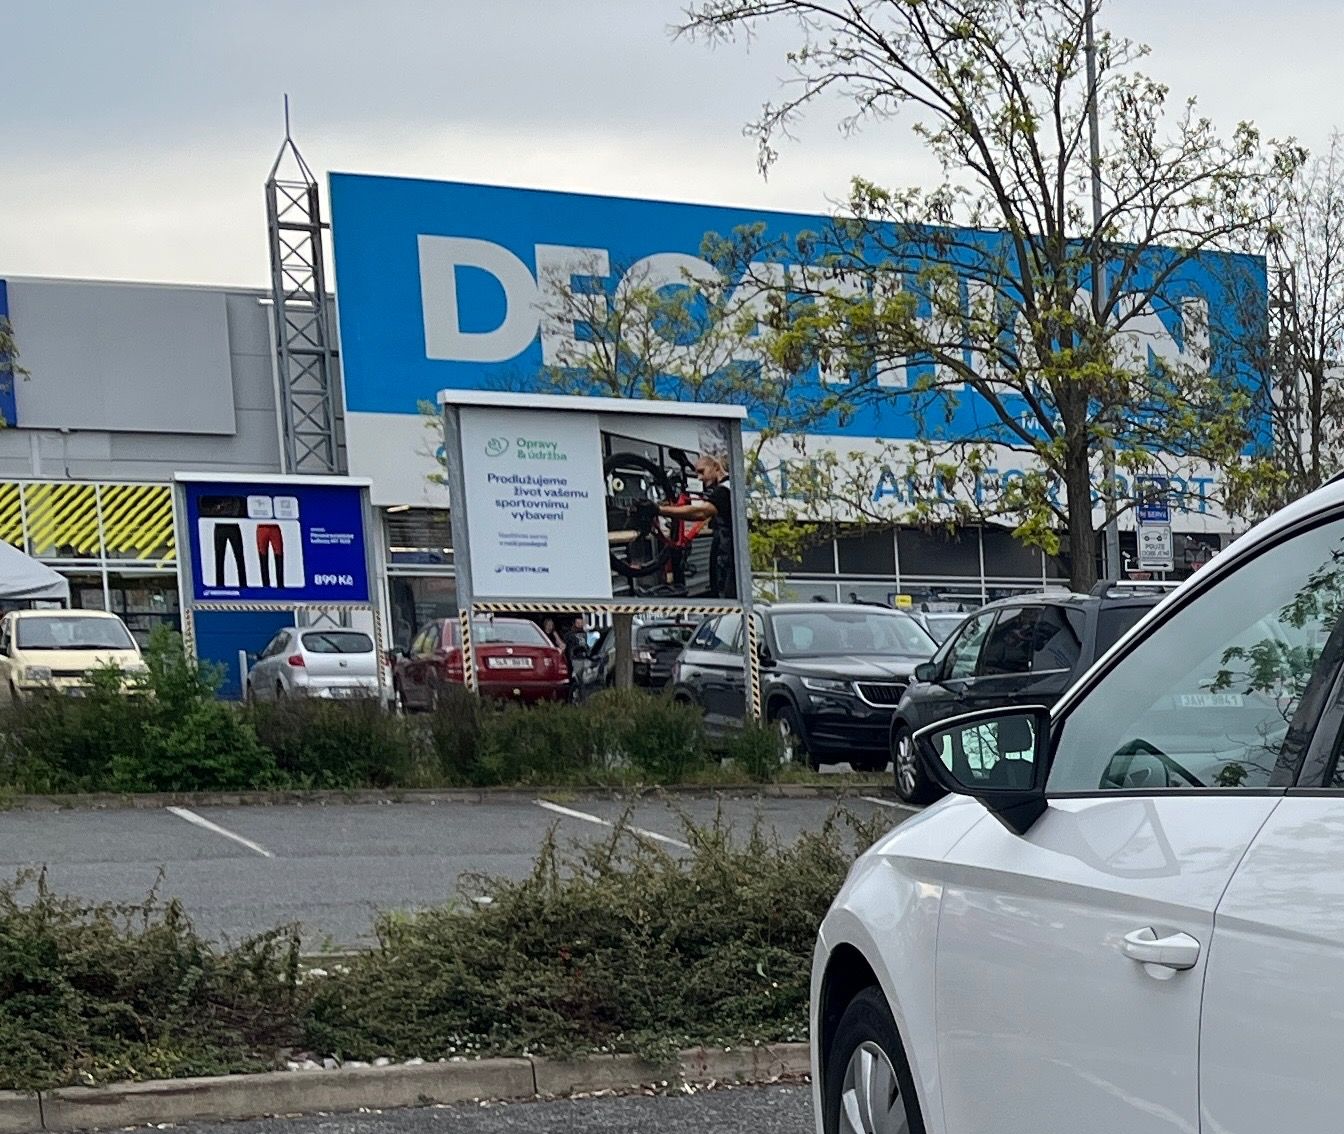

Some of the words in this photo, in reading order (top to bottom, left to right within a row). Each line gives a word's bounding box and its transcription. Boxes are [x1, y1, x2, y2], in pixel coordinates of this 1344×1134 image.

[516, 437, 558, 450] Opravy
[517, 449, 526, 459] &
[528, 450, 567, 461] údržba
[487, 473, 568, 487] Prodlužujeme
[514, 486, 542, 497] život
[545, 488, 589, 499] vašemu
